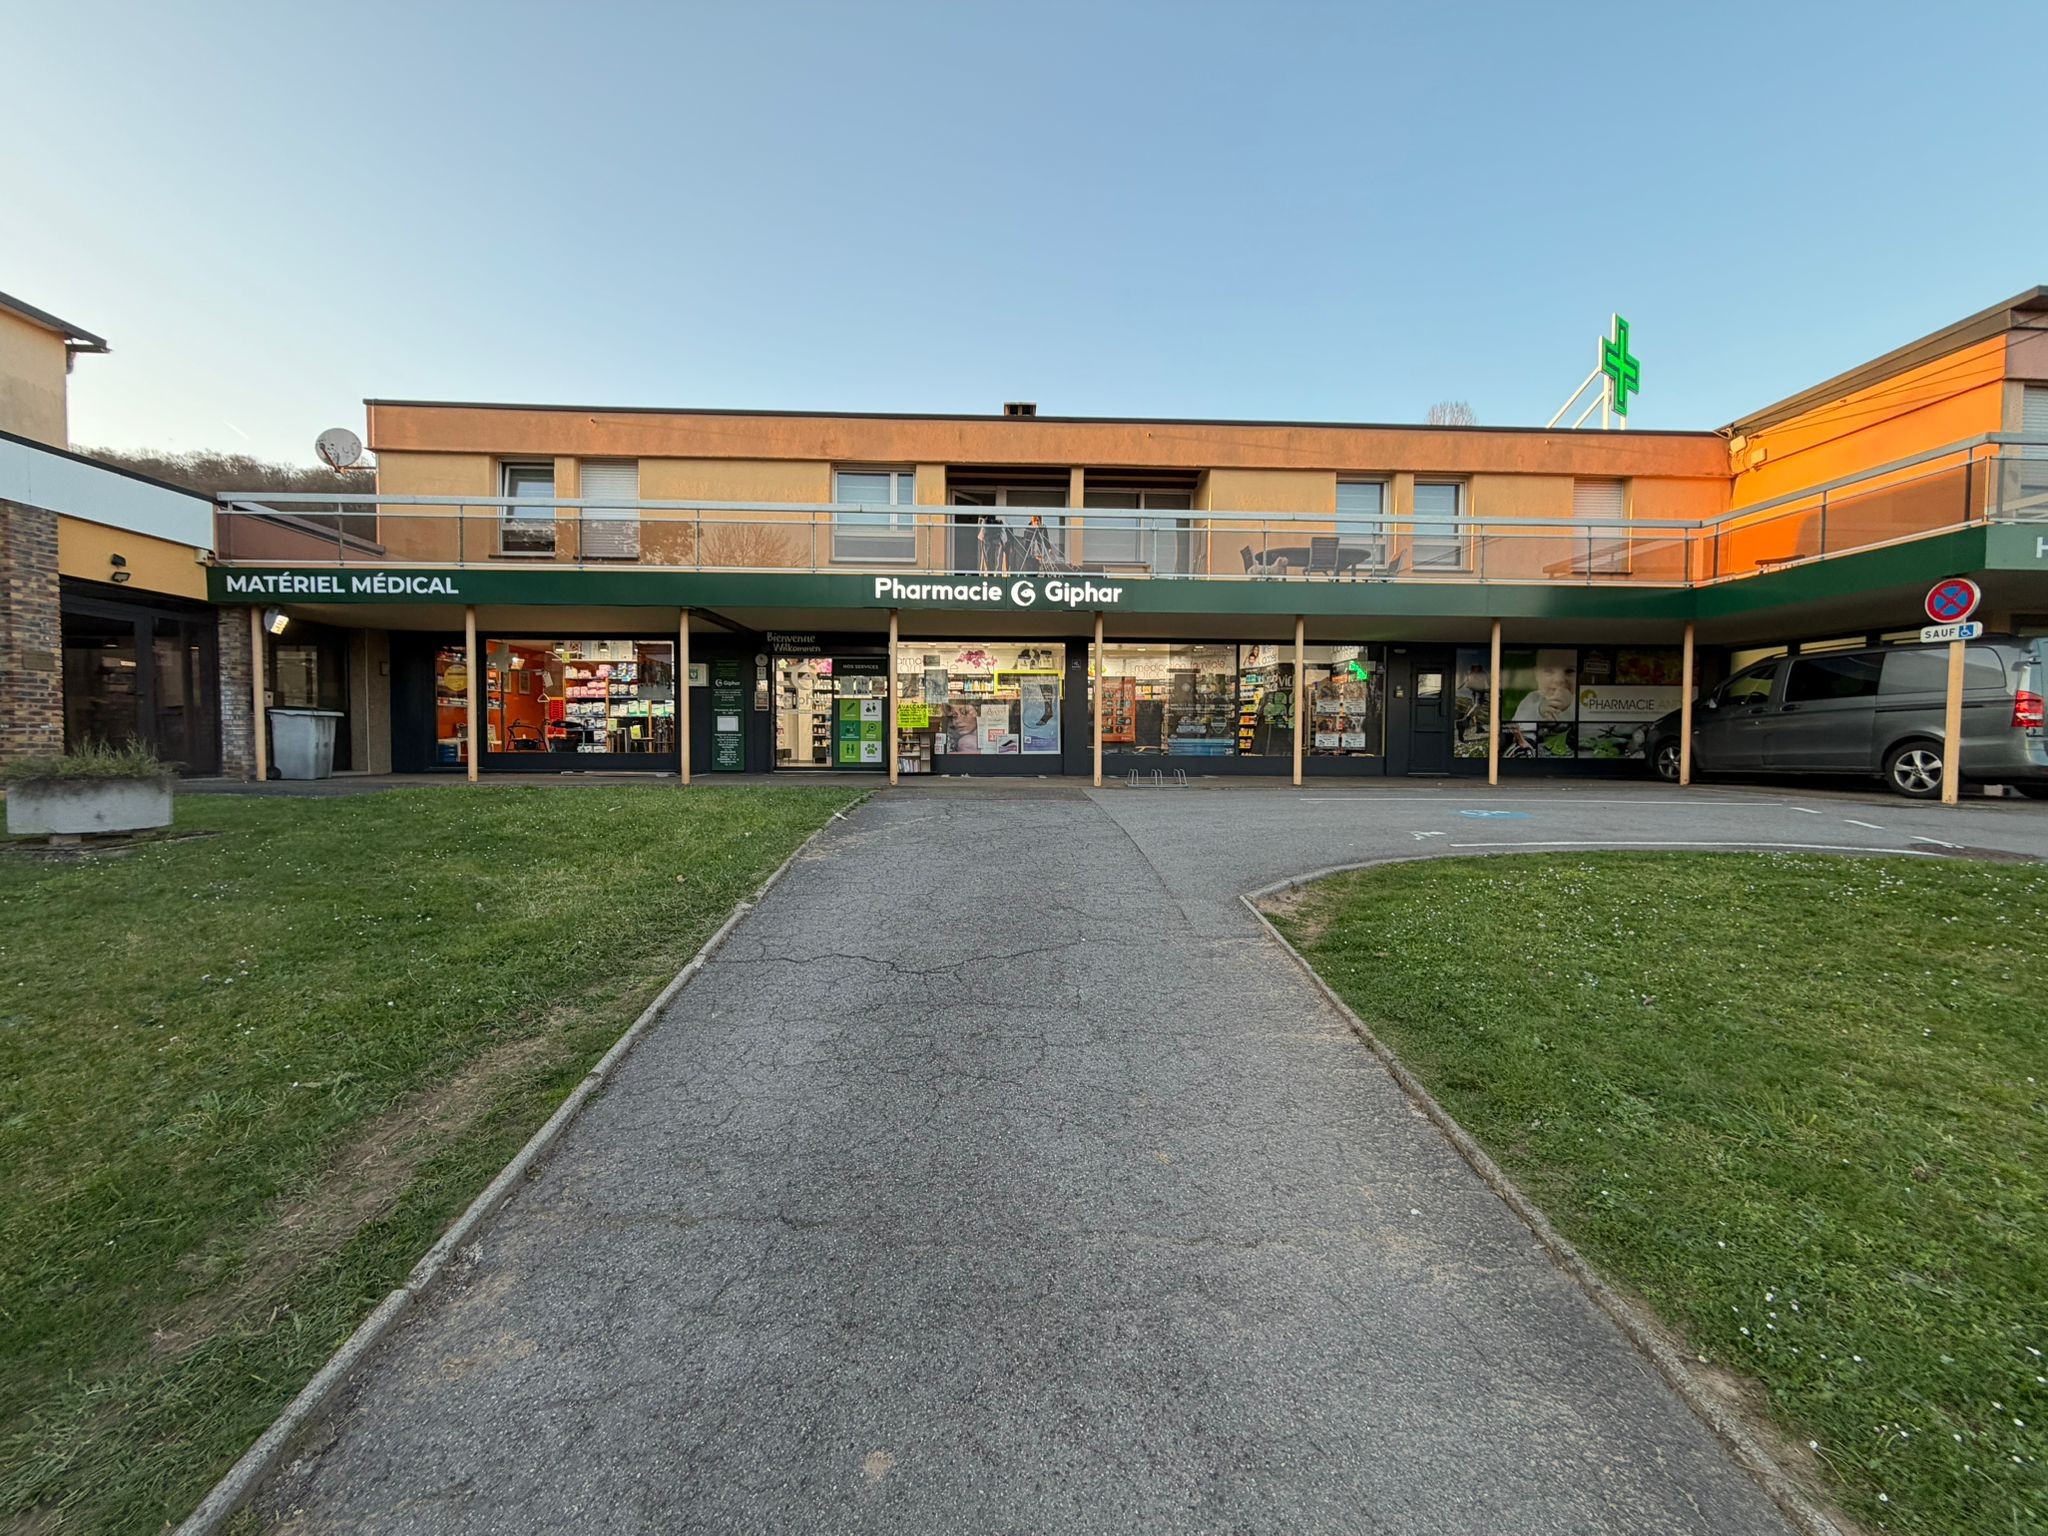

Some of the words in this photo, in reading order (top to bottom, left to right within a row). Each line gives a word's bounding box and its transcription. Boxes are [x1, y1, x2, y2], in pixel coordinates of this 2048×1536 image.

[226, 572, 346, 593] MATÉRIEL
[352, 573, 459, 594] MÉDICAL
[875, 577, 1002, 600] Pharmacie
[1045, 581, 1122, 607] Giphar
[767, 631, 816, 643] Bienvenue
[1925, 628, 1956, 639] SAUF
[1588, 699, 1655, 710] PHARMACIE
